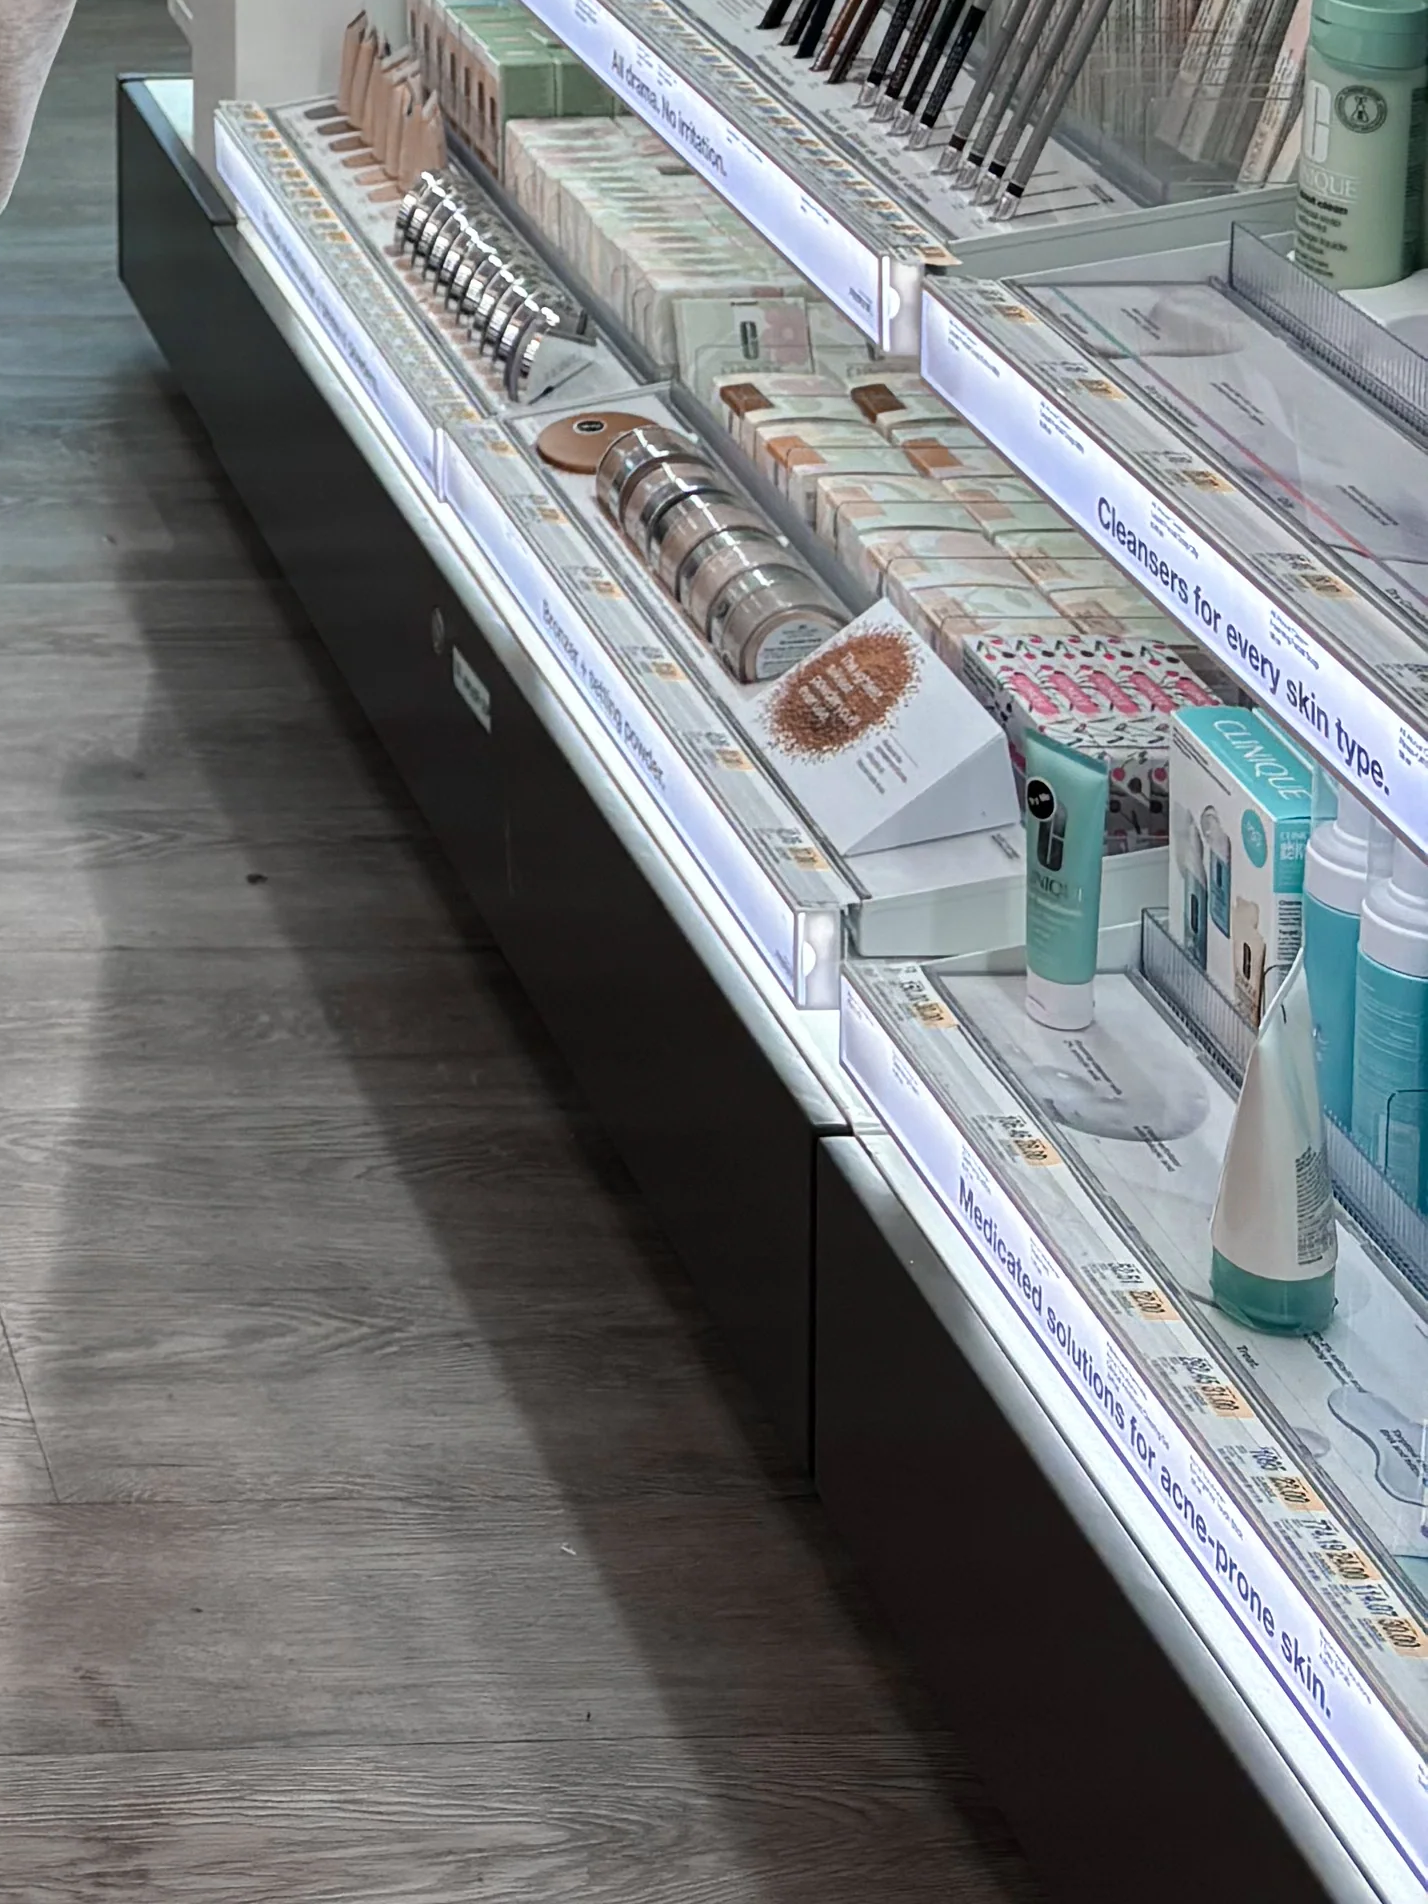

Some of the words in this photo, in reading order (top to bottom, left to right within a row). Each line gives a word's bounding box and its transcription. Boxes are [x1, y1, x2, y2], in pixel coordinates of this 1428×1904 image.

[611, 49, 625, 80] All
[661, 94, 677, 129] No
[677, 110, 728, 177] irritation.
[1097, 496, 1189, 606] Cleansers
[1193, 584, 1222, 630] for
[1227, 622, 1282, 695] every
[1286, 677, 1330, 740] skin
[1334, 716, 1391, 798] type.
[1213, 720, 1304, 801] CLINIQUE
[958, 1176, 1043, 1310] Medicated
[1045, 1306, 1128, 1430] solutions
[1129, 1419, 1157, 1469] for
[1159, 1467, 1276, 1638] acne-prone
[1279, 1630, 1333, 1720] skin.
